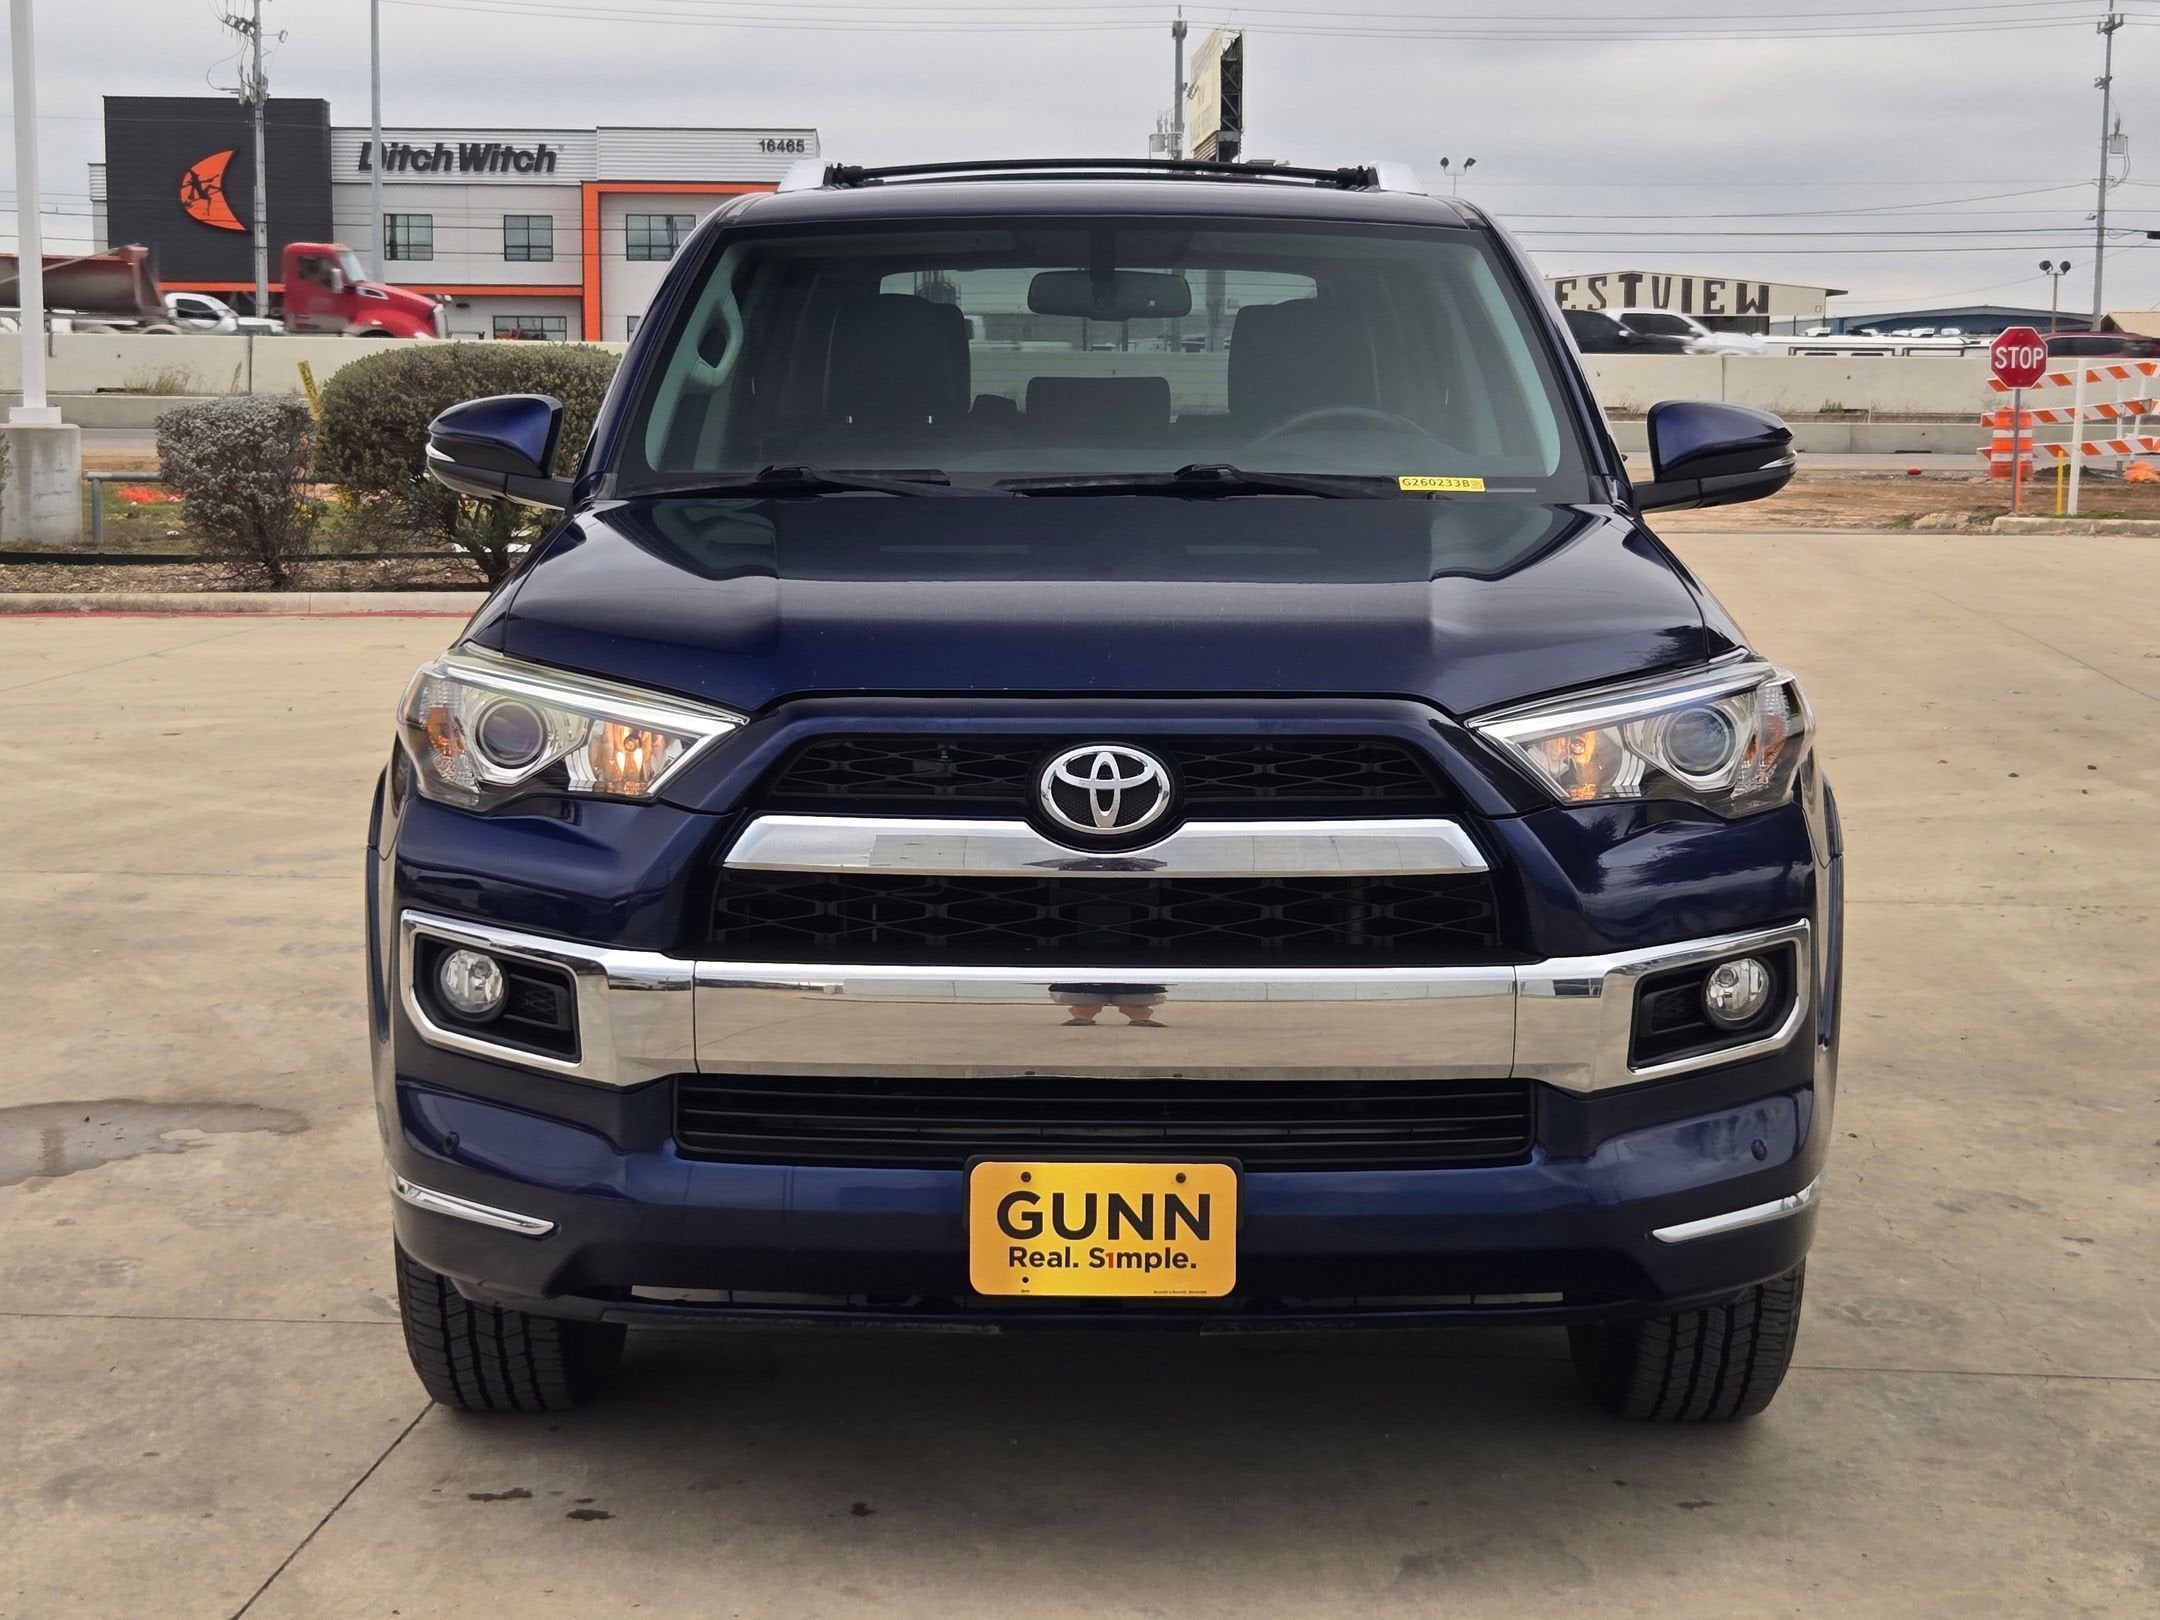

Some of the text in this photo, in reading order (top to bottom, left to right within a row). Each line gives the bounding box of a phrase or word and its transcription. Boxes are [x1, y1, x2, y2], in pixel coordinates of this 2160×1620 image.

[359, 142, 557, 172] Ditch Witch
[759, 139, 805, 153] 16465
[1555, 273, 1770, 314] ESTVIEW
[1995, 346, 2044, 369] STOP
[997, 1190, 1211, 1240] GUNN
[1009, 1246, 1079, 1268] Real.
